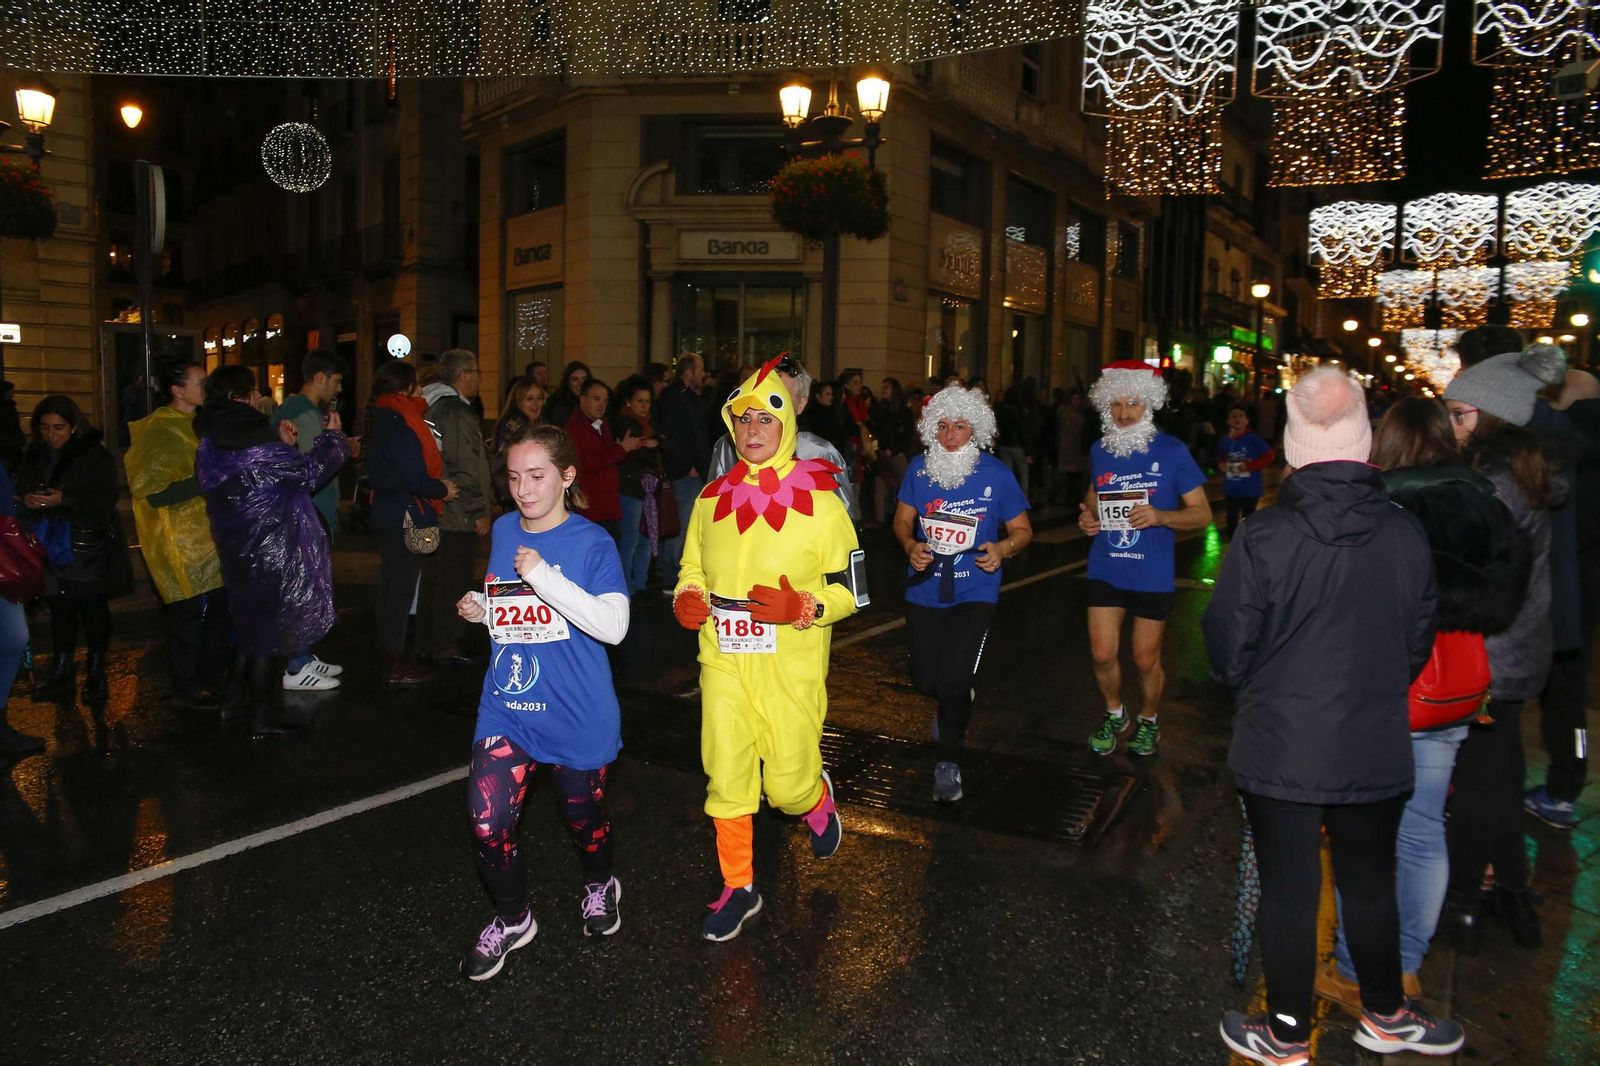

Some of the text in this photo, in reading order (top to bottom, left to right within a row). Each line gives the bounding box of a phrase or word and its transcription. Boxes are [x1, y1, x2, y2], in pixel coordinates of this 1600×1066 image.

[708, 238, 769, 255] Bankia
[514, 243, 552, 266] Bankia
[1109, 472, 1143, 485] Carrera
[1120, 480, 1159, 491] Nocturna
[940, 498, 976, 511] Carrera
[950, 506, 988, 516] Nocturna
[926, 525, 967, 545] 1570
[495, 604, 552, 626] 2240
[503, 700, 547, 712] ada2031
